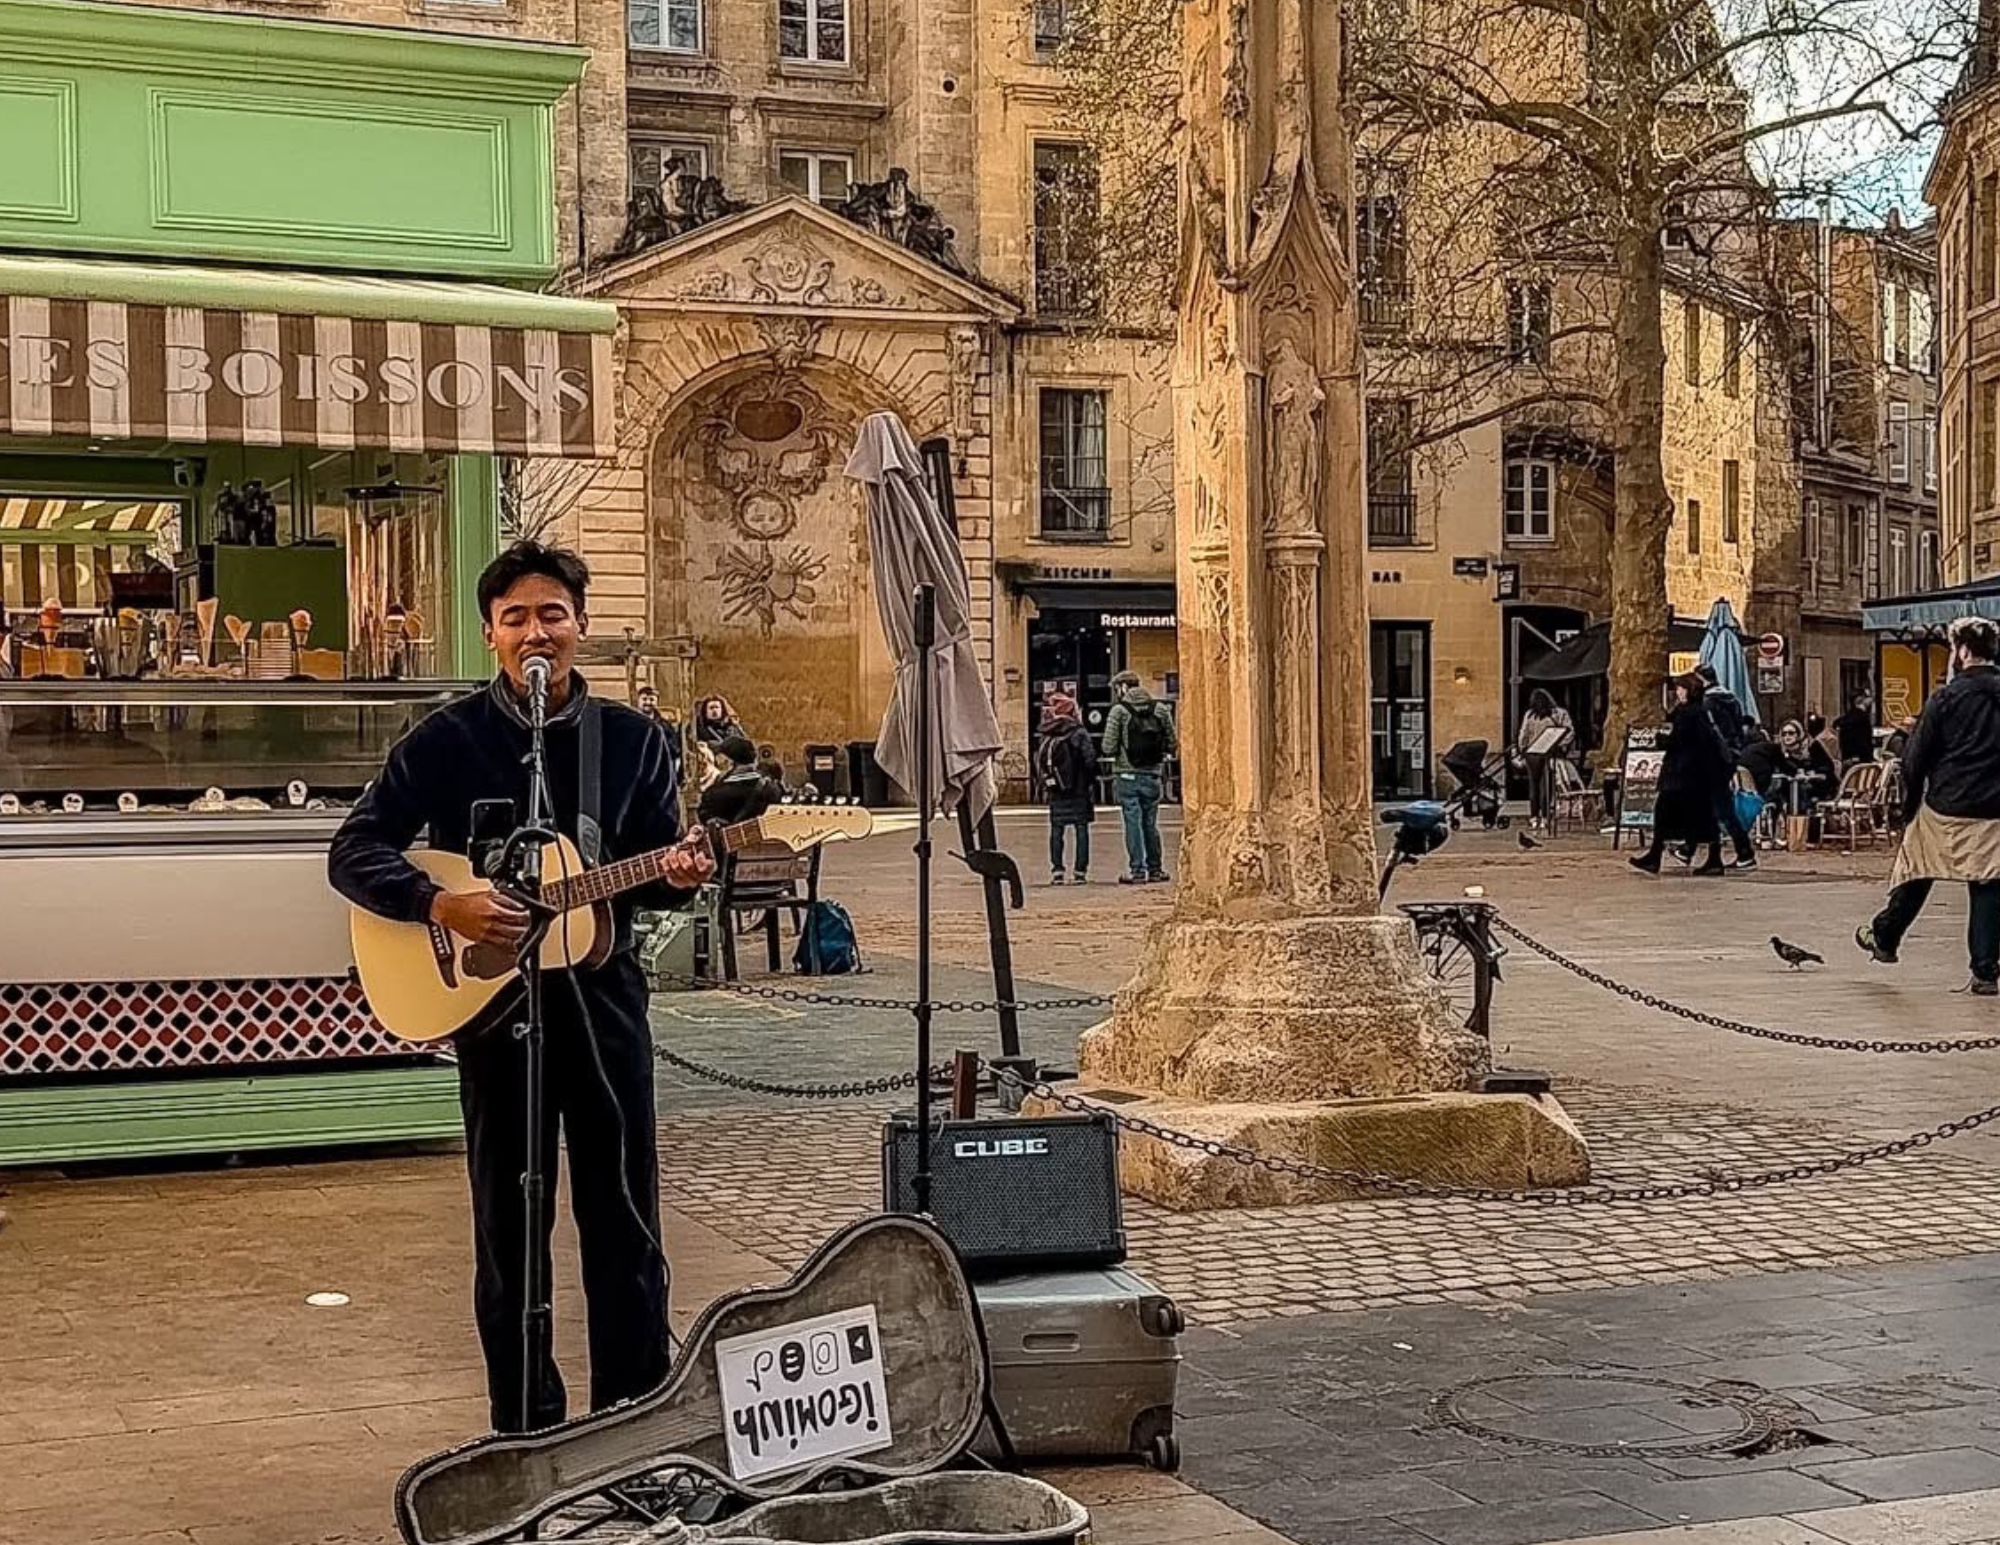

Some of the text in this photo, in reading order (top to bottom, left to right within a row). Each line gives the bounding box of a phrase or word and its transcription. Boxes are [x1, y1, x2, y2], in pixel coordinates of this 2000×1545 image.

[0, 334, 589, 414] ES BOISSONS
[1044, 567, 1112, 580] KITCHEN
[1372, 571, 1402, 583] BAR
[954, 1138, 1049, 1158] CUBE
